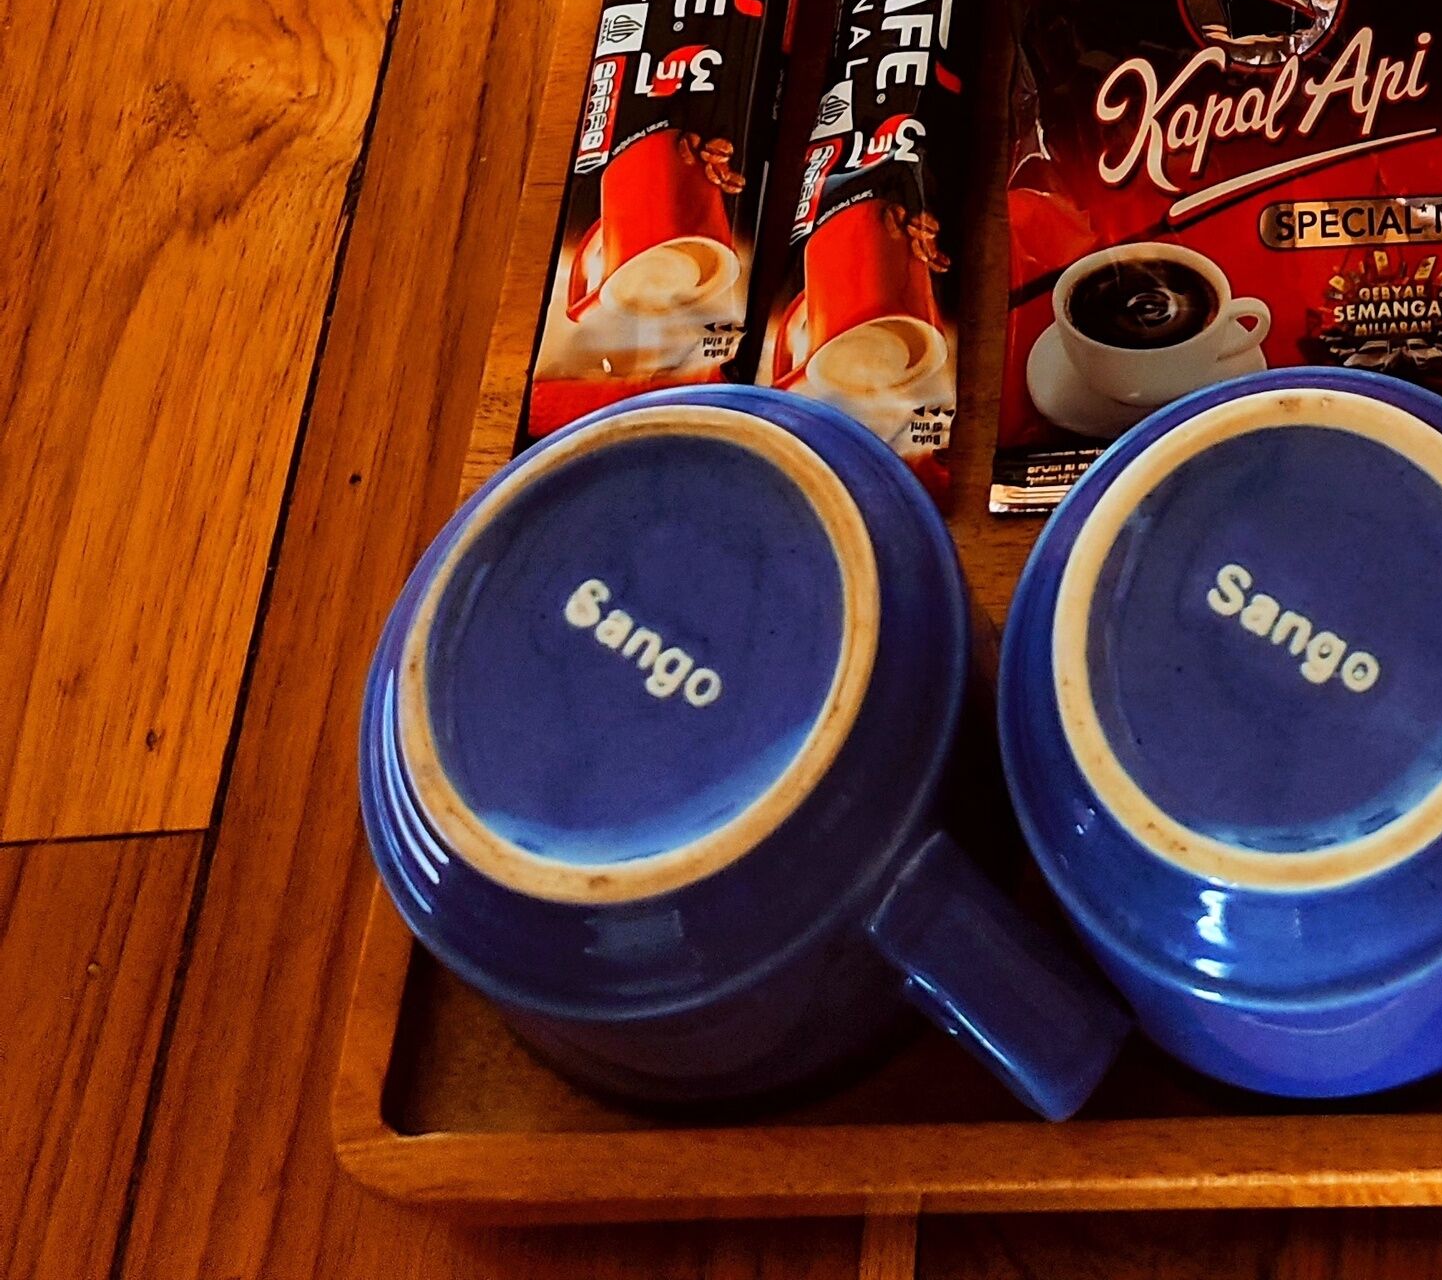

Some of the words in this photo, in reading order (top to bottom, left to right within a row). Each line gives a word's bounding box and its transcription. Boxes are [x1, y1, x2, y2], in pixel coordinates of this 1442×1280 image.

[1095, 44, 1305, 192] Kapal
[1297, 26, 1435, 137] Api
[1275, 205, 1424, 241] SPECIAL
[1359, 284, 1425, 302] GEBYAR
[1354, 319, 1433, 337] MILIARAN
[1204, 561, 1382, 696] Sango
